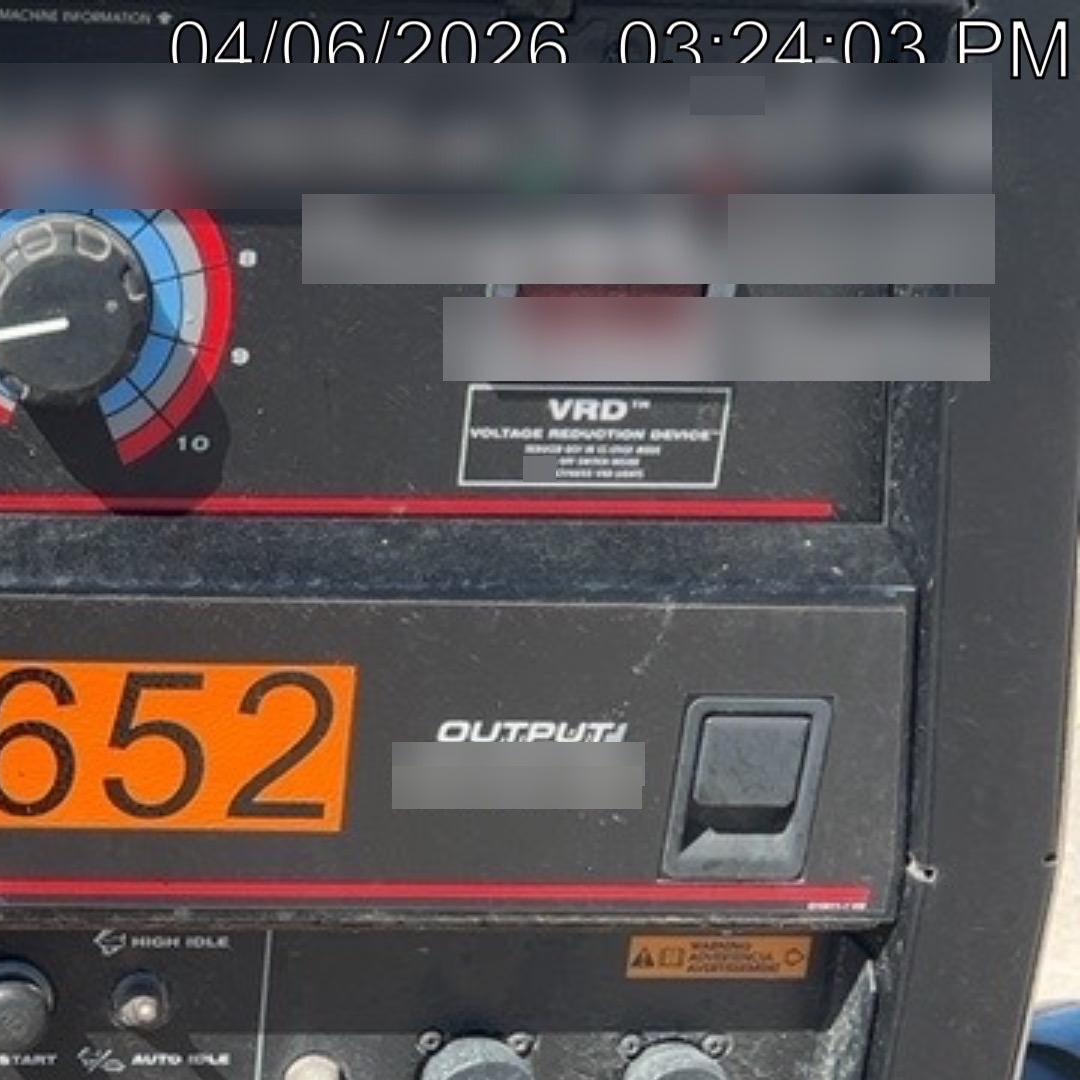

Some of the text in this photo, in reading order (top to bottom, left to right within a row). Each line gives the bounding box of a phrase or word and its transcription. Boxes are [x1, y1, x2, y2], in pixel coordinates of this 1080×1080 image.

[231, 347, 250, 365] 9
[470, 427, 542, 440] VOLTAGE
[548, 428, 646, 441] REDUCTION
[177, 436, 210, 451] 10
[131, 936, 229, 948] HIGH IDLE
[132, 1054, 230, 1066] AUTO IDLE
